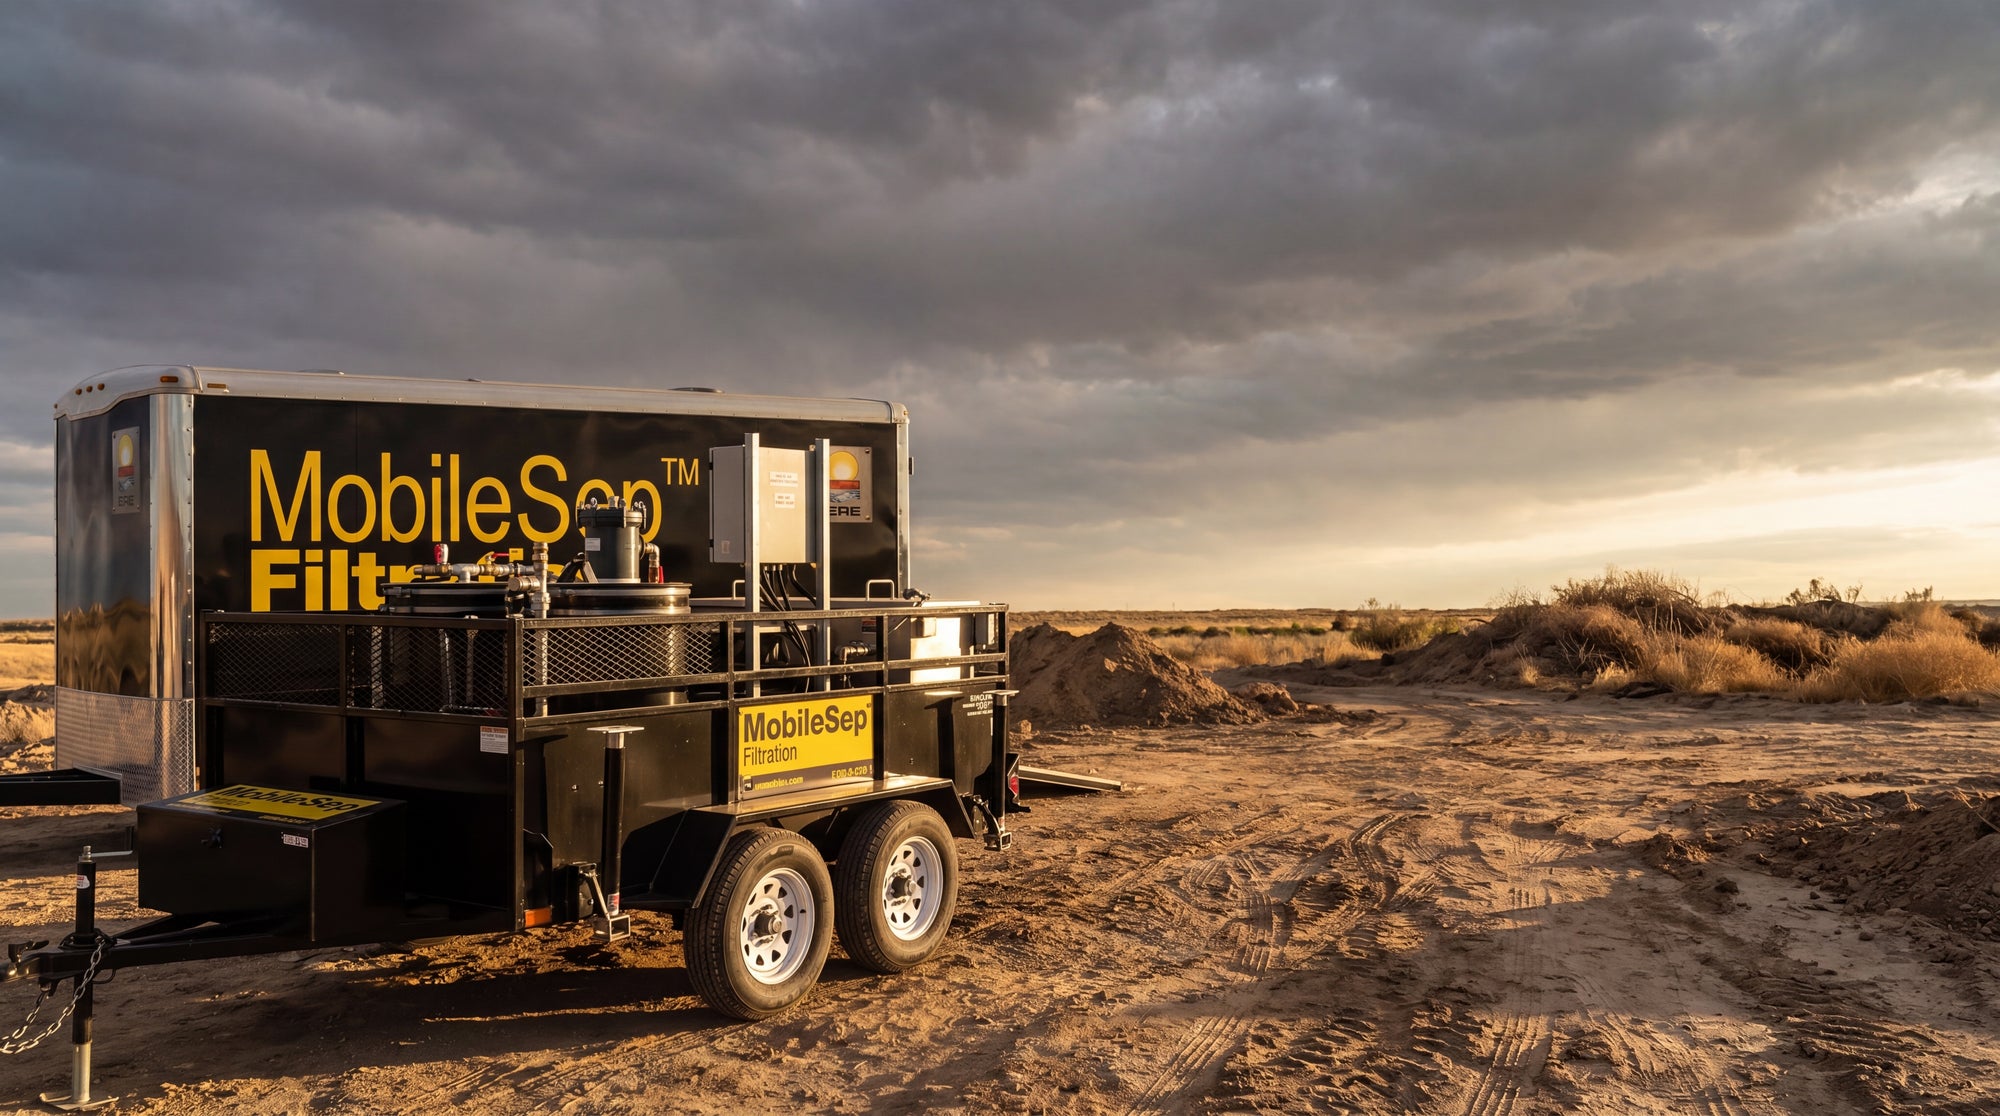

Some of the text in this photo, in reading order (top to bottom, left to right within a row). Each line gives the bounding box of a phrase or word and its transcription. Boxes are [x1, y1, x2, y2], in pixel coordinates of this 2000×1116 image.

[744, 704, 867, 743] MobileSep
[743, 743, 798, 766] Filtration
[215, 786, 359, 812] MobileSep
